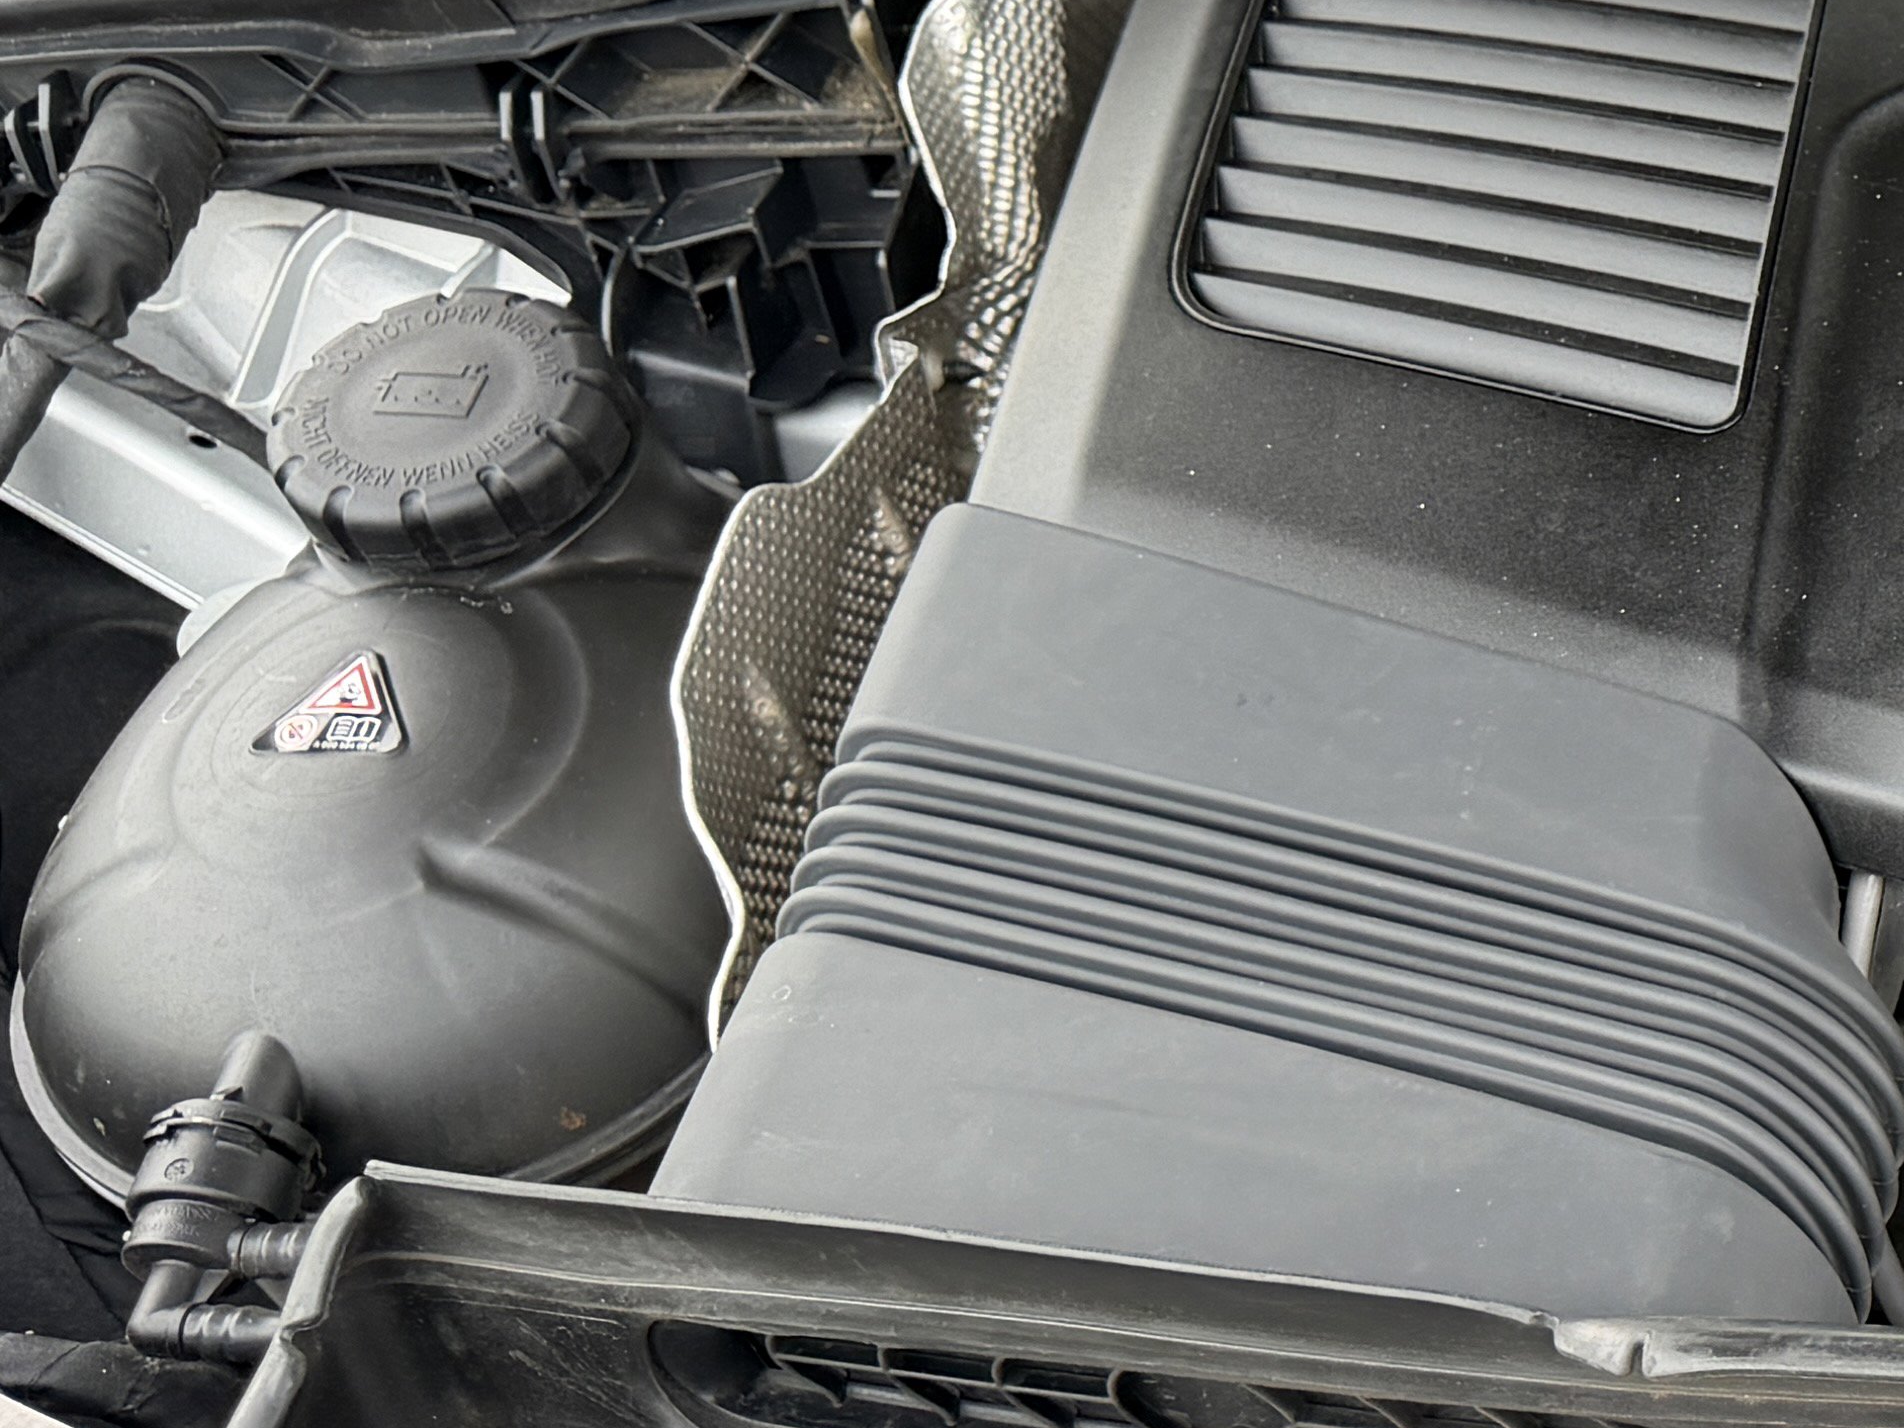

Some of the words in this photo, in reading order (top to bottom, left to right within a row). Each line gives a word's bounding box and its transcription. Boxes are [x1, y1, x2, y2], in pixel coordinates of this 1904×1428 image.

[365, 315, 413, 348] NOT
[423, 306, 491, 329] OPEN
[494, 308, 550, 353] WHEN
[402, 452, 474, 488] WENN
